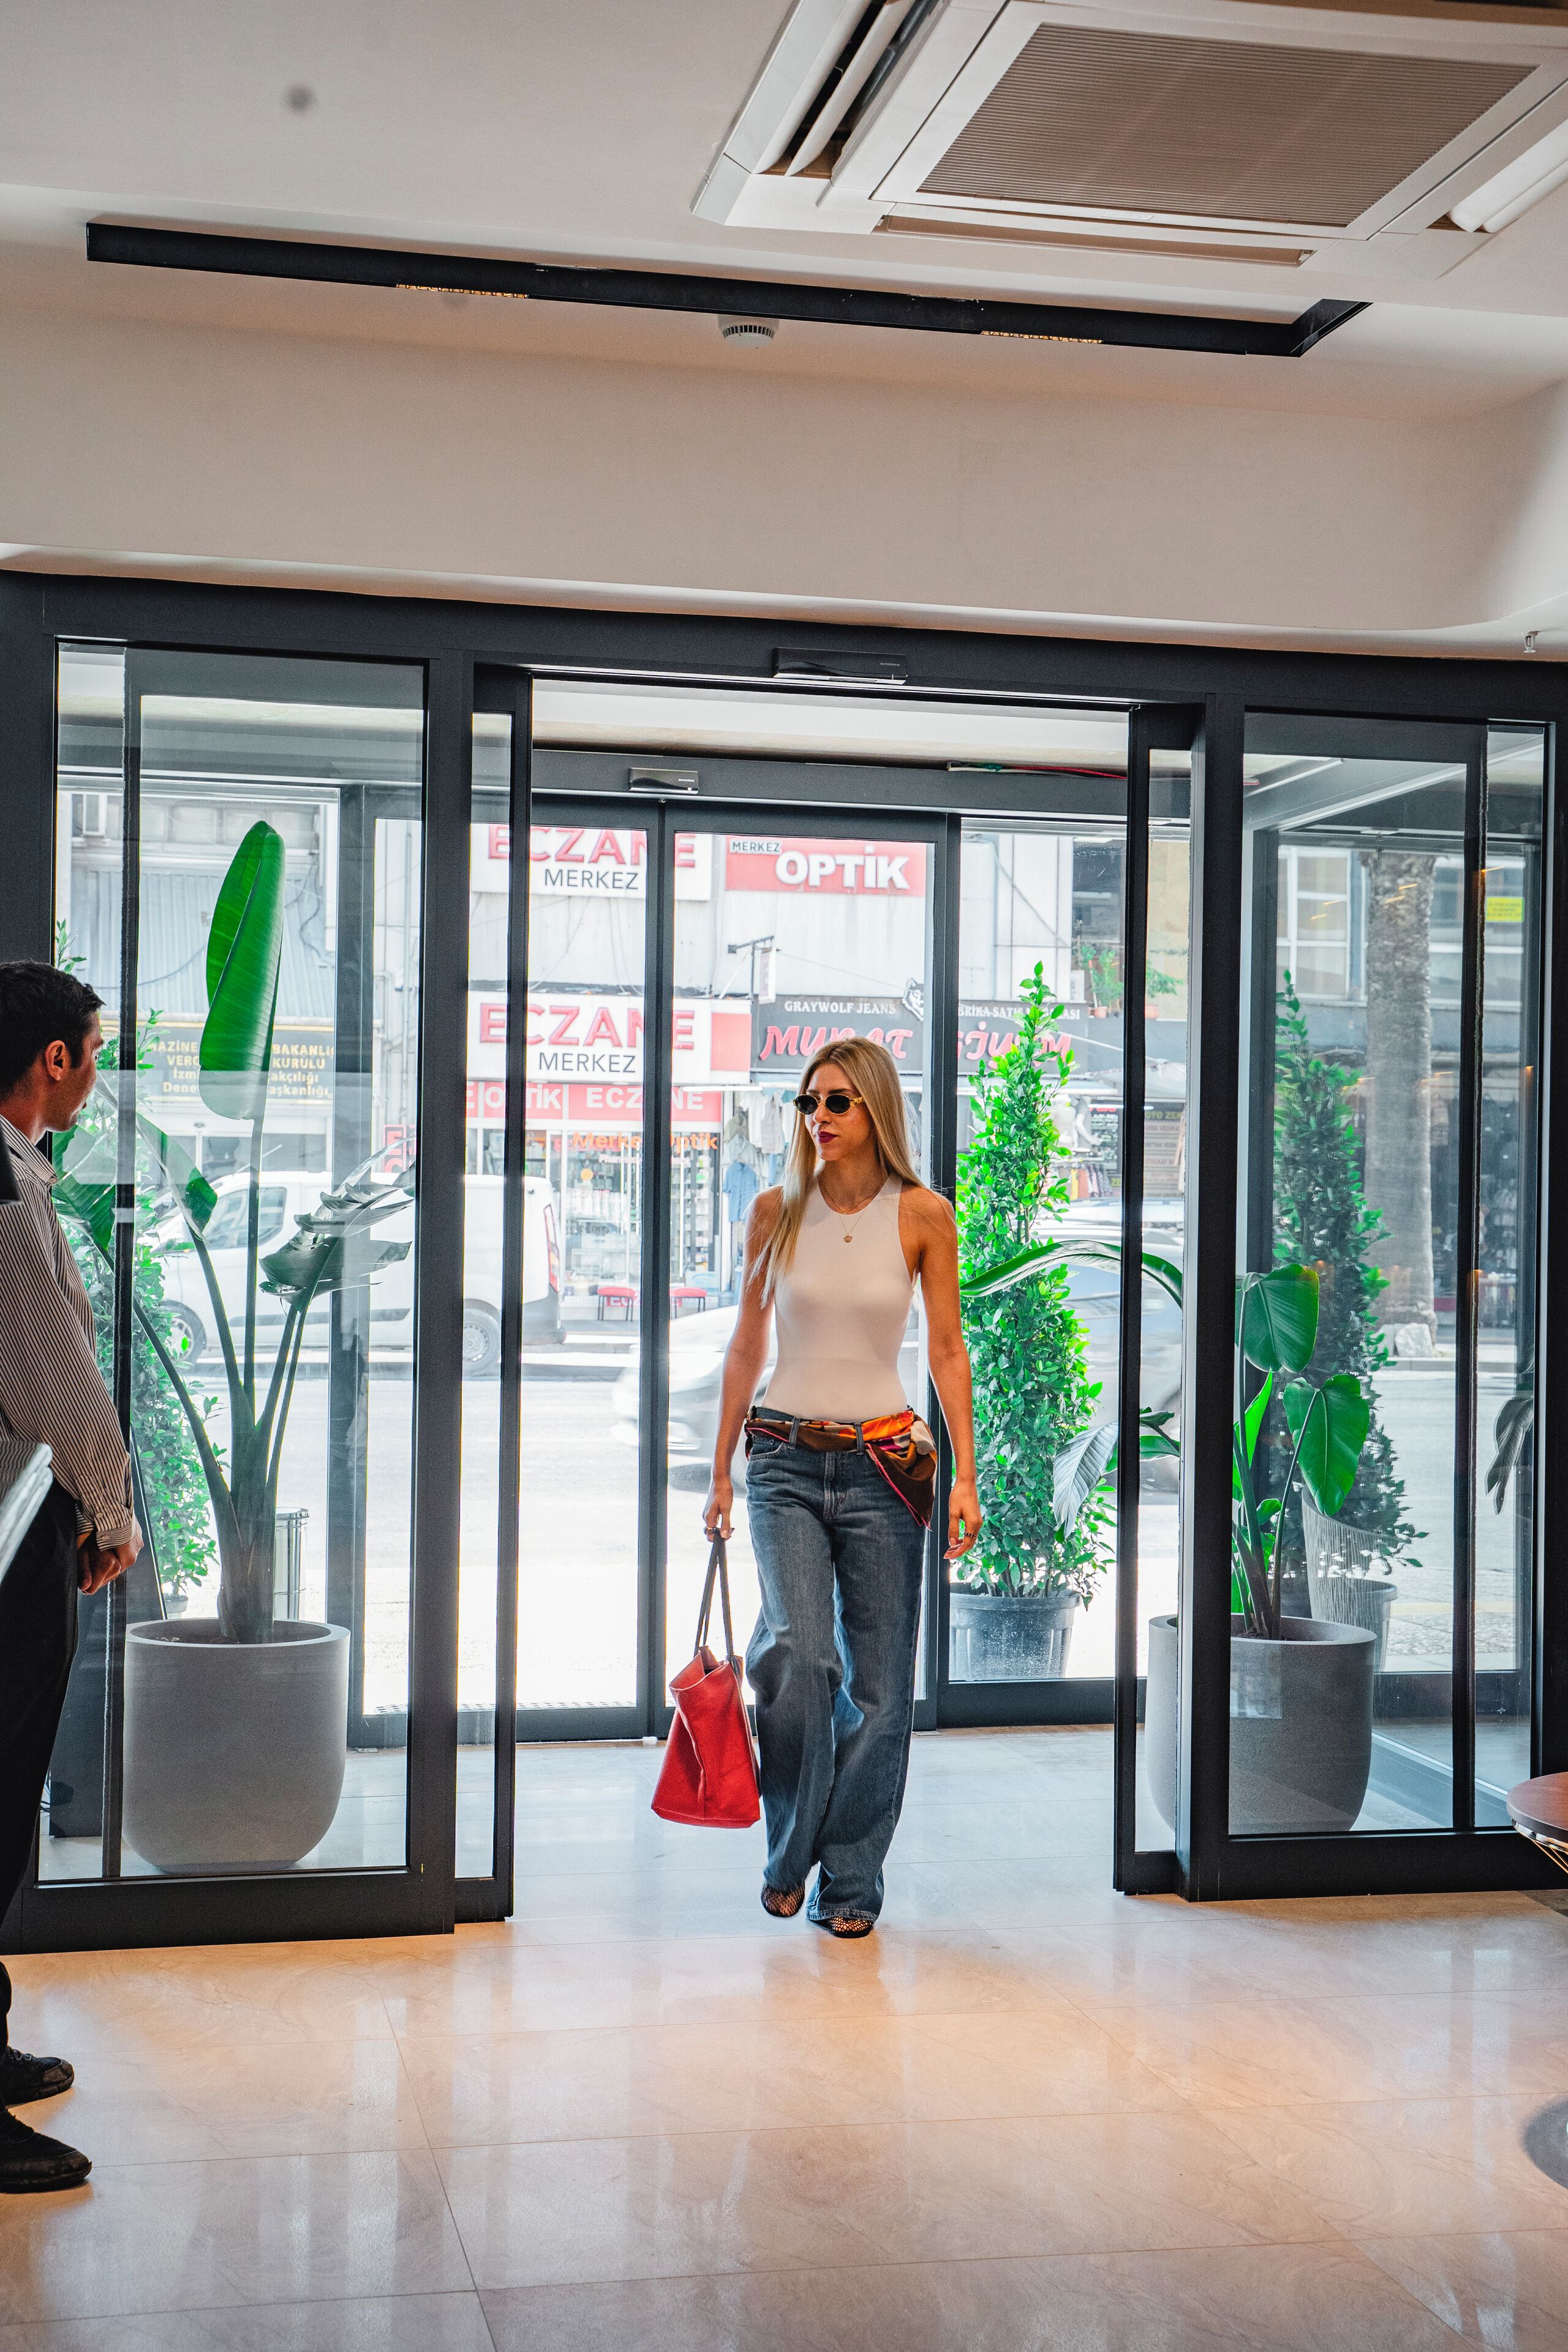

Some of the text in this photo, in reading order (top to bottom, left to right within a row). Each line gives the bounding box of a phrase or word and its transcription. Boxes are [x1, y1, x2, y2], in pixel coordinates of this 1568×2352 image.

[733, 841, 780, 852] MERKEZ
[775, 844, 910, 890] OPTİK
[545, 869, 639, 890] MERKEZ
[784, 1000, 896, 1015] GRAYWOLF JEANS
[959, 1004, 991, 1017] BRİKA
[272, 1044, 334, 1057] BAKANLI
[167, 1054, 326, 1069] VERG KURULU
[539, 1052, 636, 1073] MERKEZ
[173, 1066, 319, 1085] İzm akçılığı
[163, 1082, 329, 1098] Dene aşkanlığı
[484, 1084, 562, 1110] OTİK
[586, 1087, 704, 1110] ECZNE
[572, 1132, 642, 1150] Merke
[671, 1132, 718, 1155] ptik
